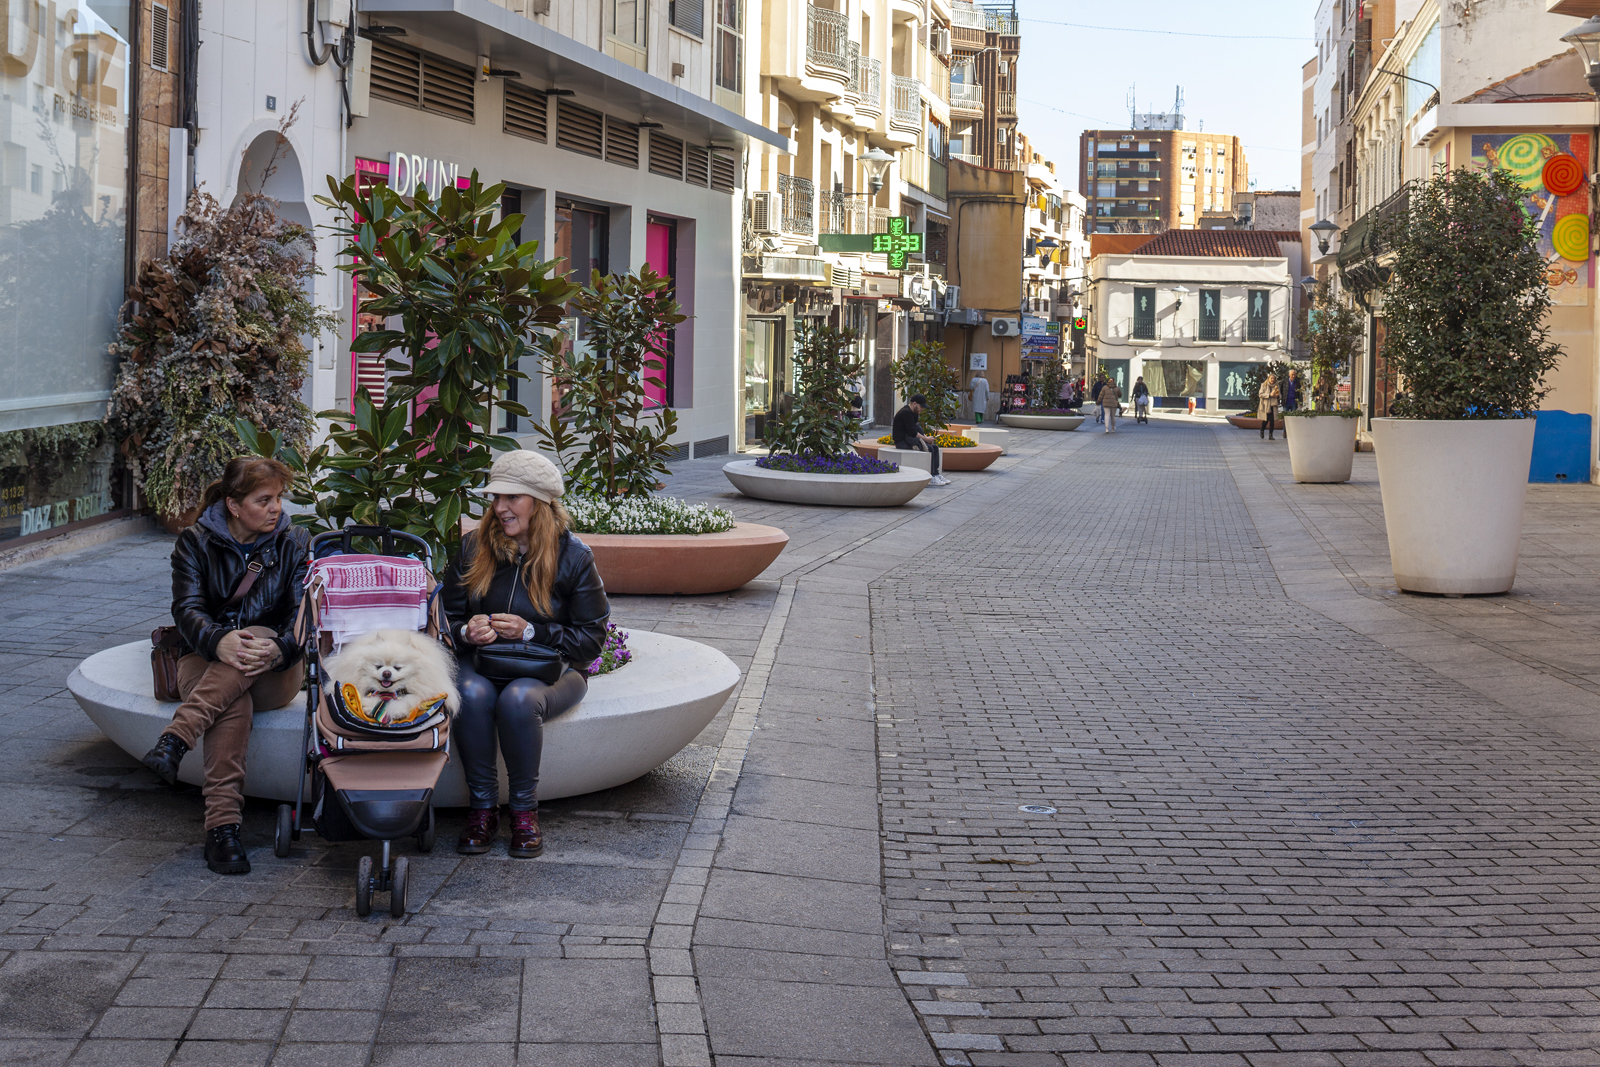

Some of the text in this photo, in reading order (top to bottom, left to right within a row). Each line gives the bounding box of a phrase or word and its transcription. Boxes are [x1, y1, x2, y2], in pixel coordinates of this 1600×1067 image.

[54, 93, 117, 128] Floristas Estrella
[394, 151, 459, 201] DRUNI
[873, 235, 919, 252] 13:33
[10, 486, 17, 498] 13
[17, 485, 25, 497] 29
[20, 491, 110, 537] DIAZ ESTRELLA
